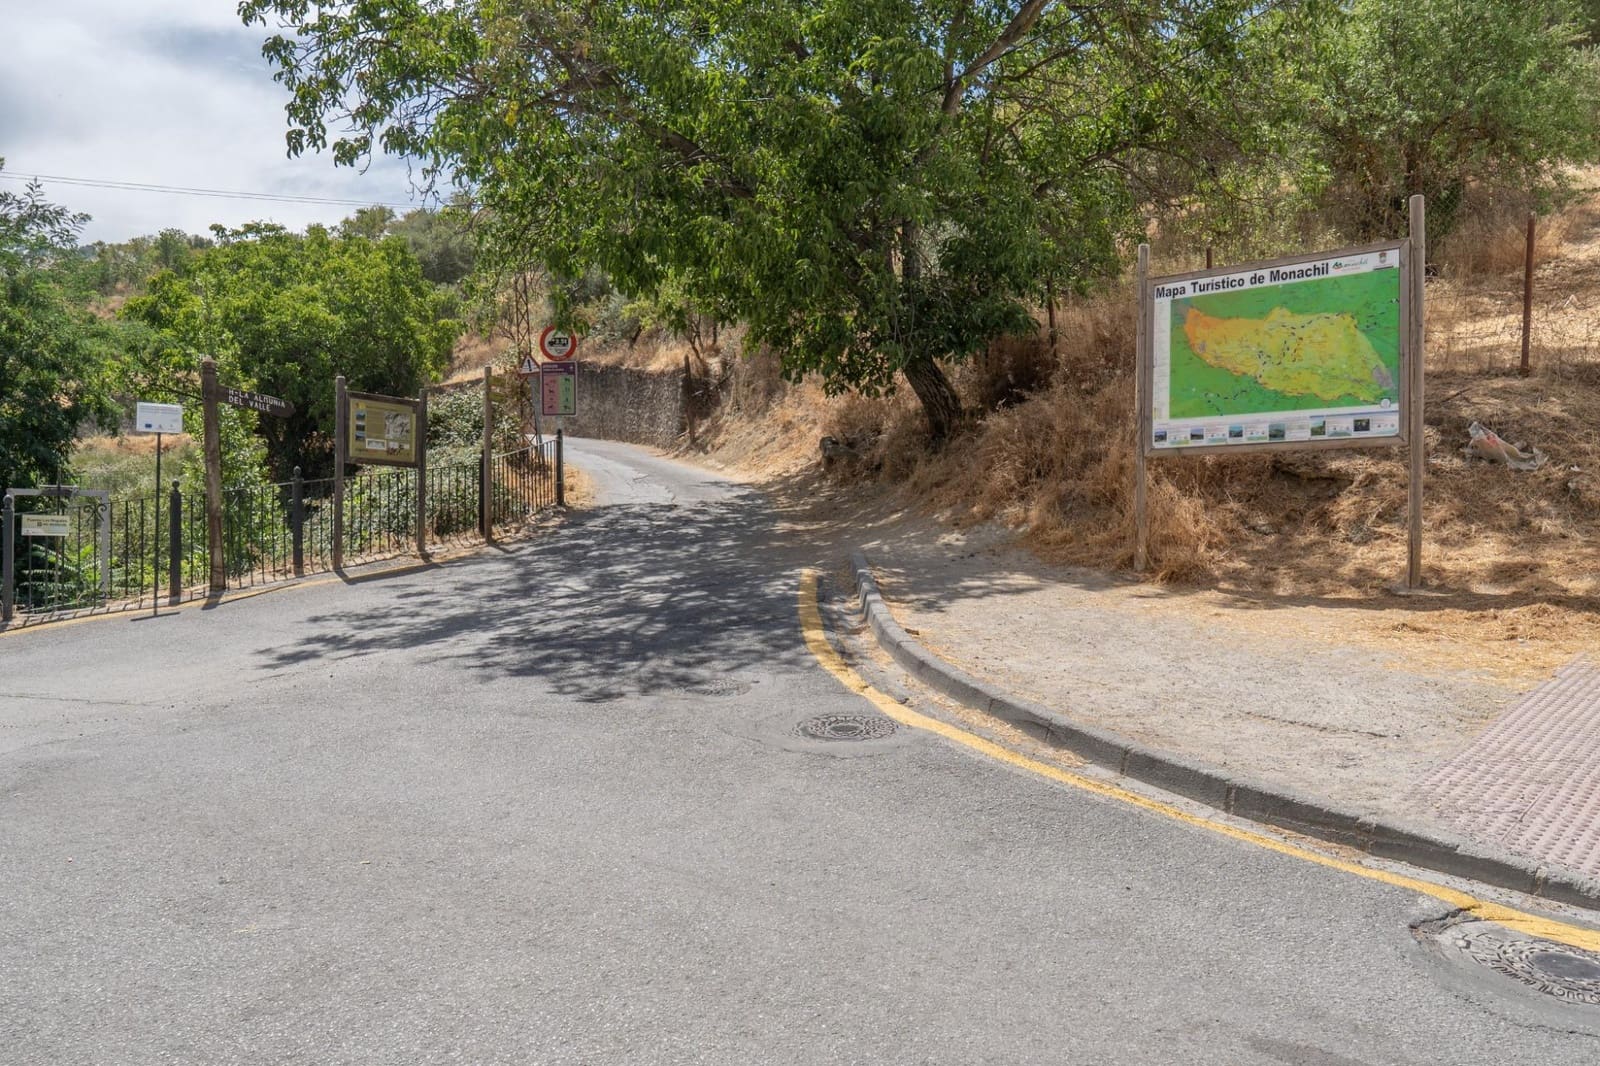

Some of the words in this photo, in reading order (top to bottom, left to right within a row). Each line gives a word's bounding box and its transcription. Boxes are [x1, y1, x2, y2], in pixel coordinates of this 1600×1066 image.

[1156, 285, 1186, 299] Mapa
[1250, 273, 1265, 286] de
[1269, 263, 1329, 282] Monachil
[228, 395, 245, 406] DEL
[249, 400, 271, 412] VALLE
